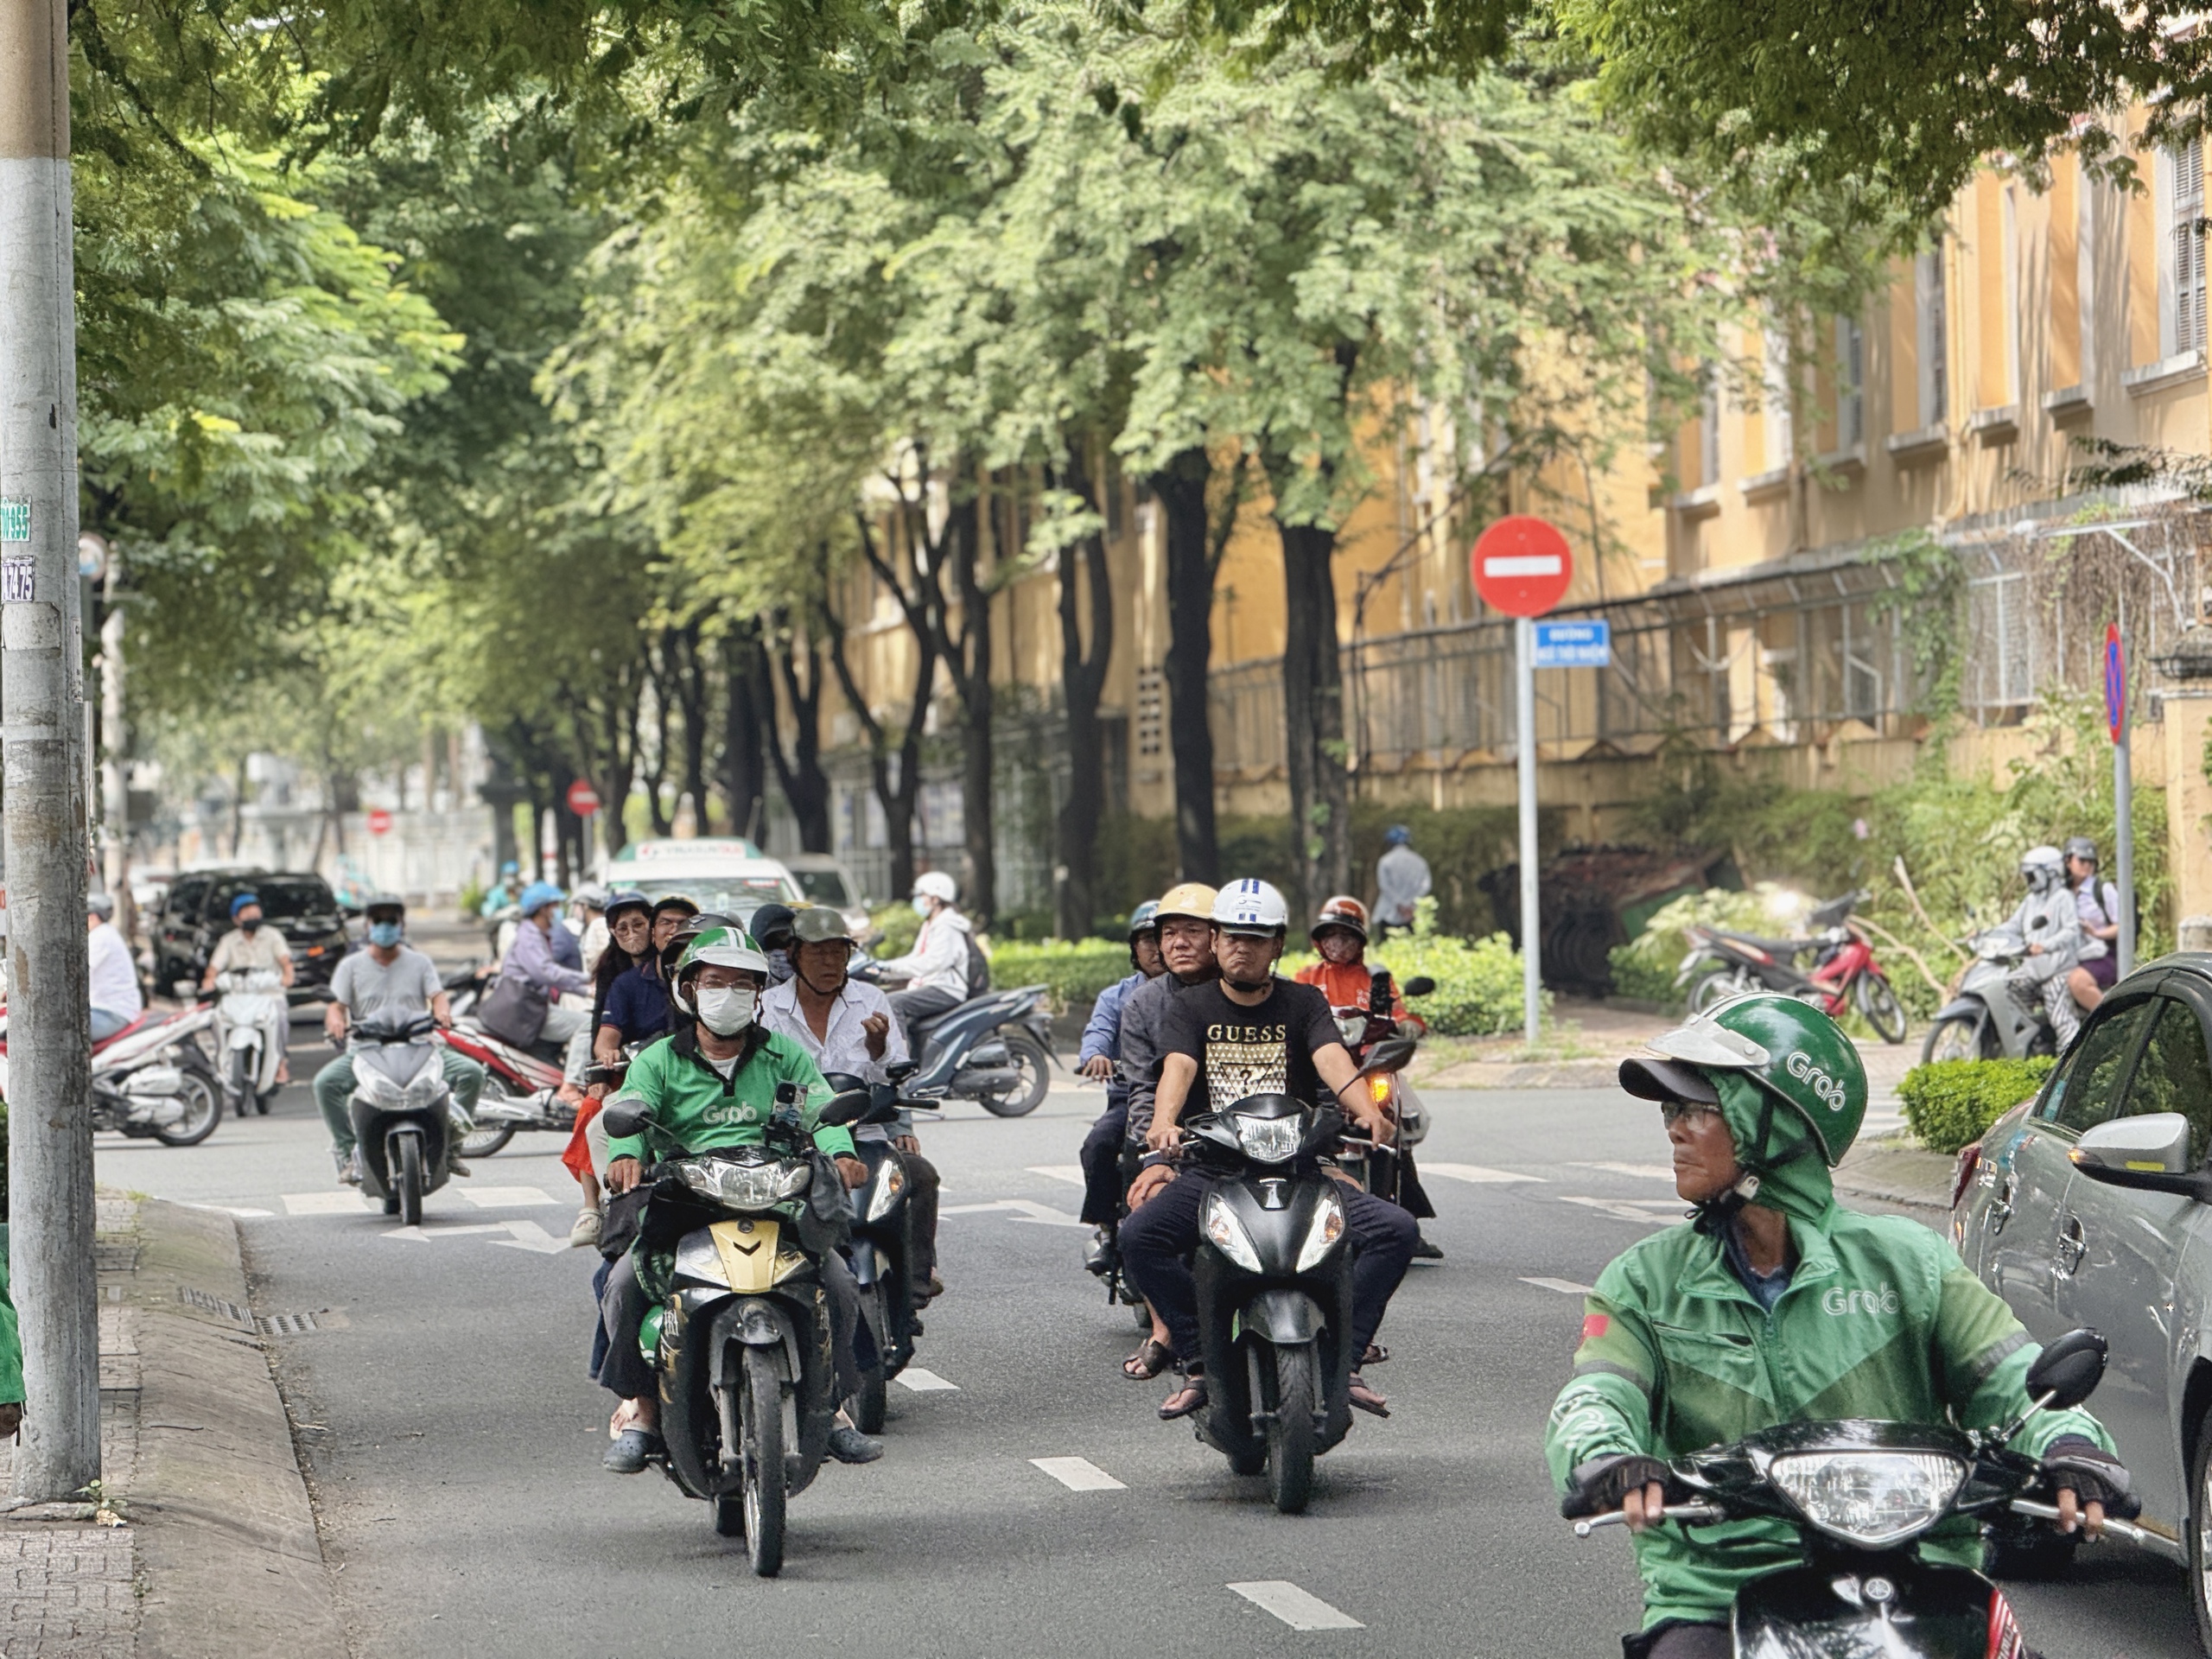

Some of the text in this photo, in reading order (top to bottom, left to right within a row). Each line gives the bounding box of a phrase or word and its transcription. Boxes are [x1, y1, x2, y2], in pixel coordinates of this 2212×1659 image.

[1207, 1024, 1287, 1042] GUESS
[1787, 1052, 1847, 1112] Grab
[702, 1101, 758, 1125] Grab
[1821, 1281, 1901, 1316] Grab
